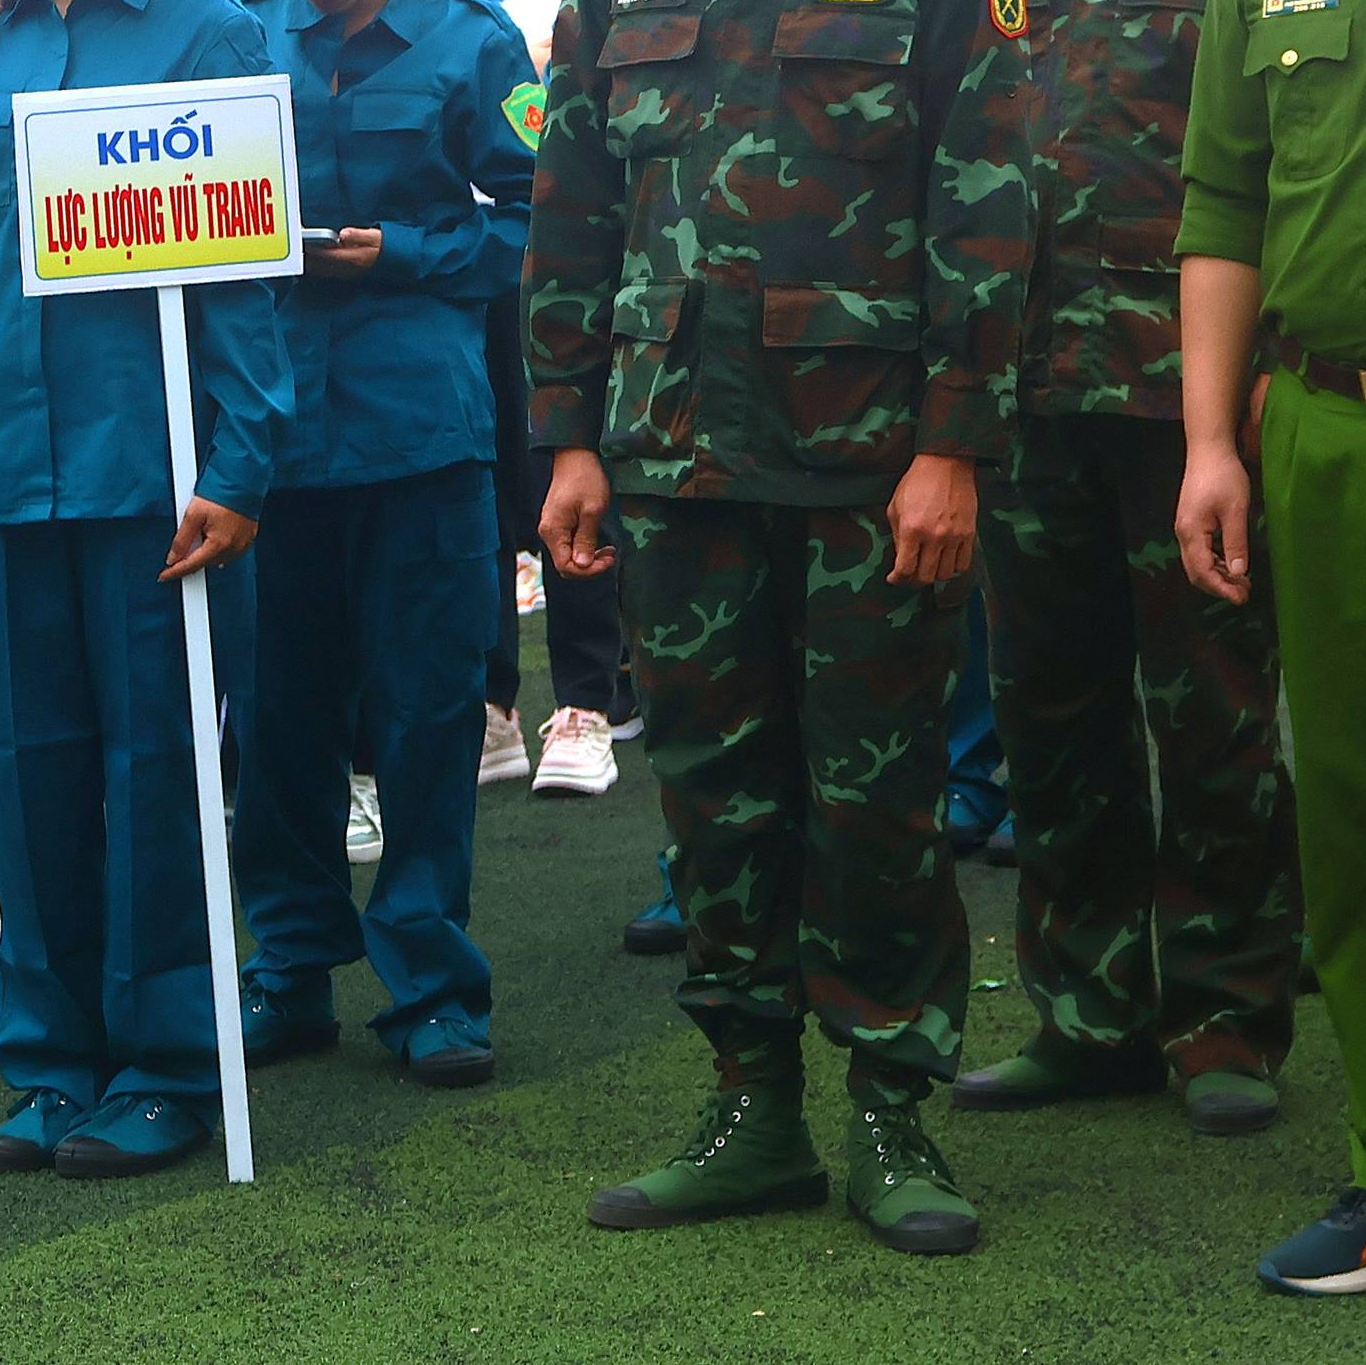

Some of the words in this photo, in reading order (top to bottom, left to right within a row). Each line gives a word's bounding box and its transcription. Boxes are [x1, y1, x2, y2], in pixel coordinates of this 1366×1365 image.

[97, 109, 213, 165] KHỐI
[45, 188, 86, 265] LỰC
[91, 183, 165, 260] LƯỢNG
[168, 172, 199, 243] VŨ
[202, 178, 275, 239] TRANG
